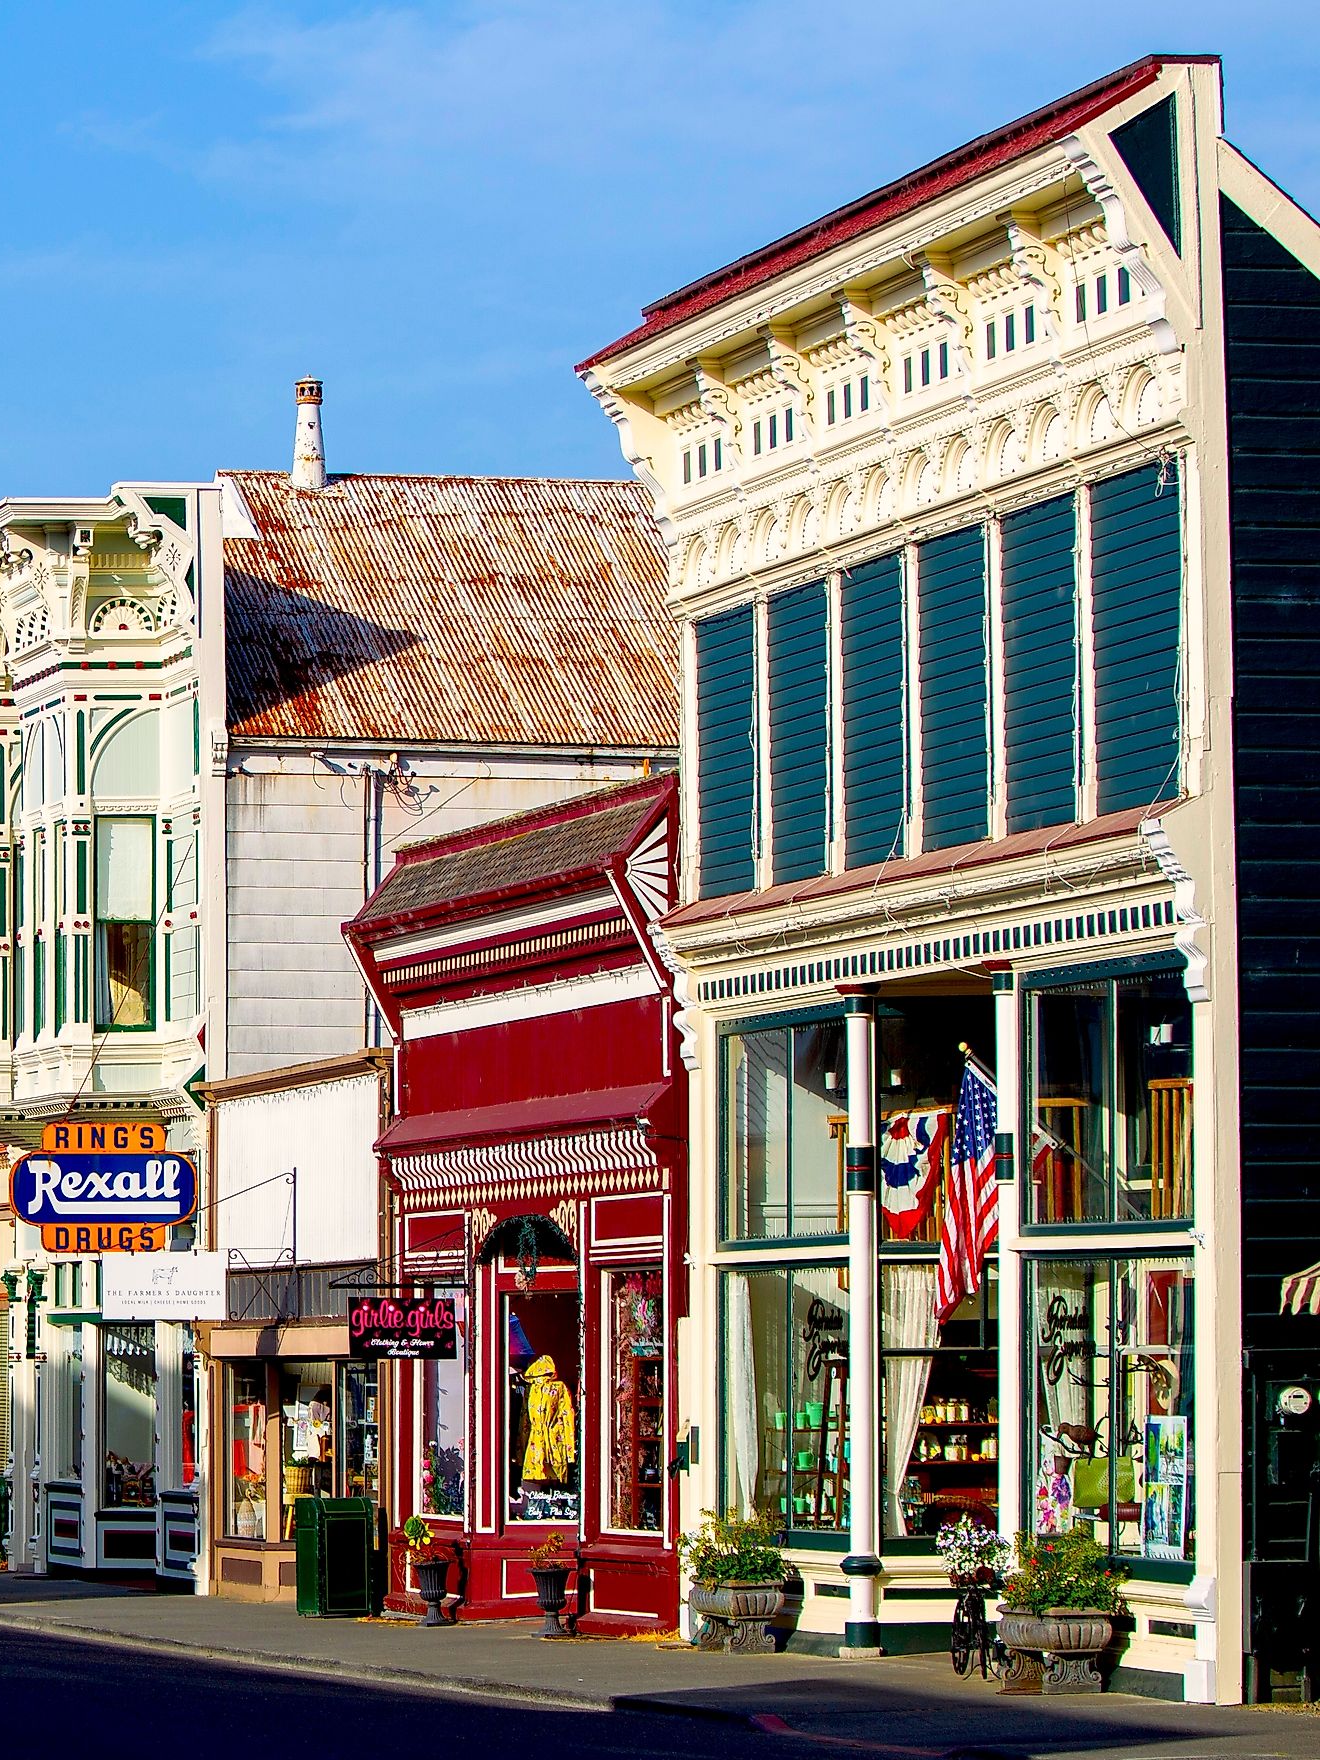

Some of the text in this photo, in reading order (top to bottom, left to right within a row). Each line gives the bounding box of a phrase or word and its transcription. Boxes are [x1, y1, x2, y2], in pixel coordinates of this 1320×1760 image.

[55, 1126, 154, 1149] RING'S
[27, 1159, 180, 1215] Rexall
[55, 1227, 154, 1249] DRUGS
[351, 1300, 454, 1337] girlie girls
[371, 1339, 400, 1348] Clothing
[387, 1349, 420, 1358] Boutique
